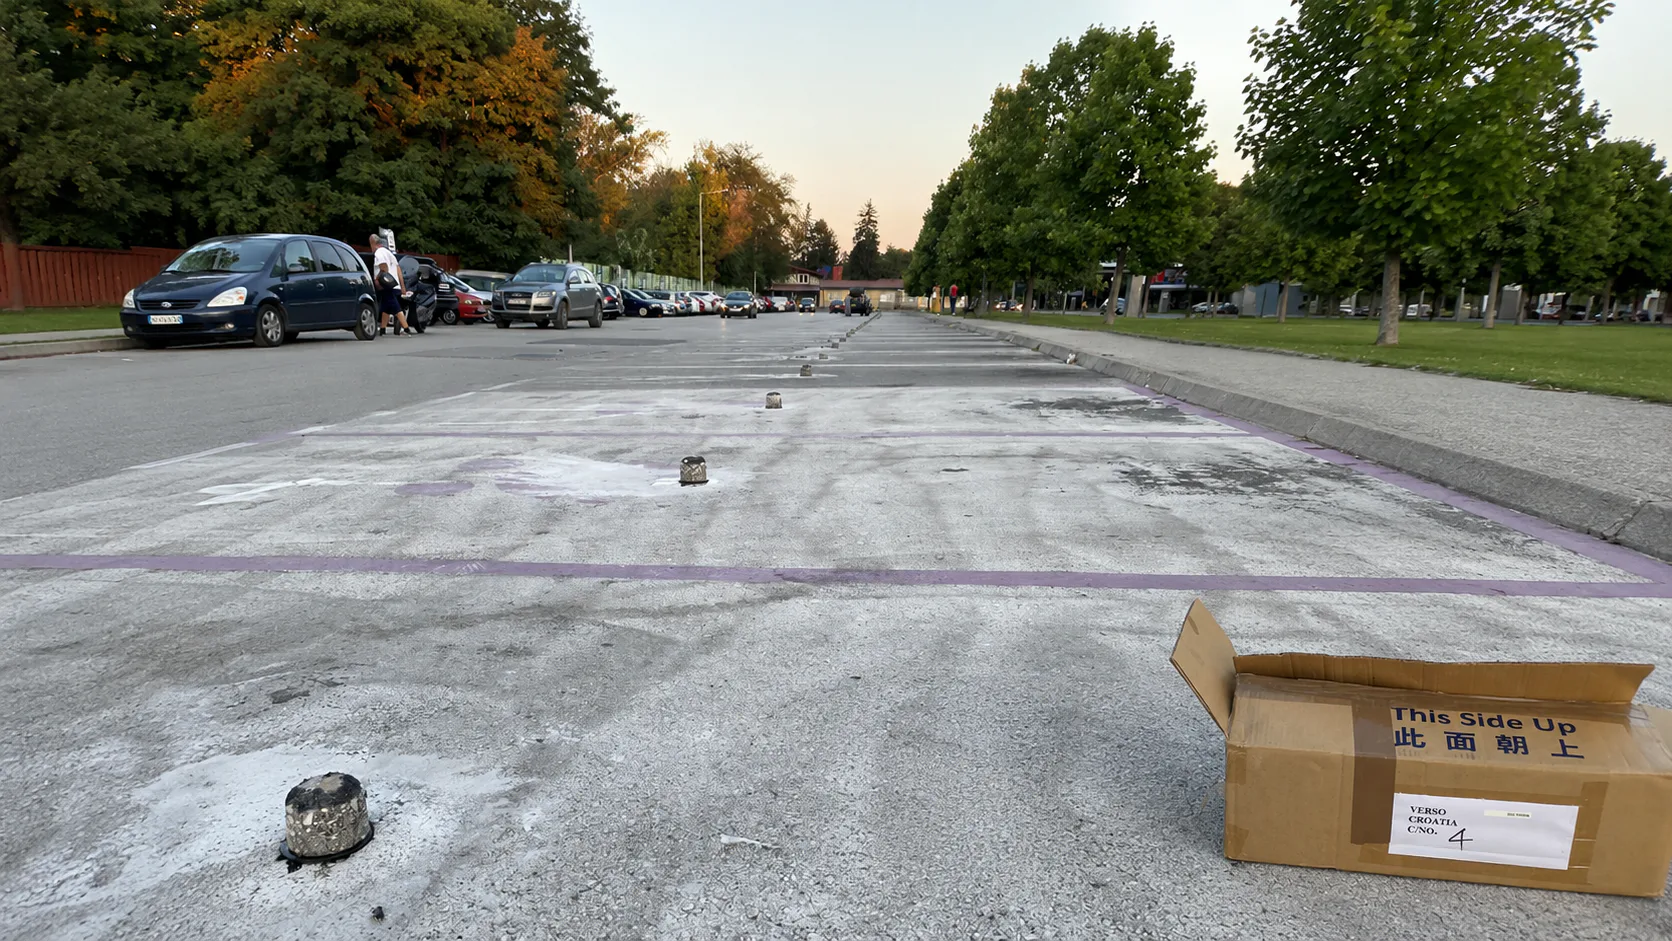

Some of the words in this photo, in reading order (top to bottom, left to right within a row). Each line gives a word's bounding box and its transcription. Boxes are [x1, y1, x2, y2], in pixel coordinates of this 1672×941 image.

[1391, 706, 1451, 725] This
[1460, 712, 1523, 731] Side
[1532, 718, 1576, 736] Up
[1394, 727, 1585, 759] 此面朝上
[1408, 815, 1458, 827] CROATIA
[1410, 805, 1447, 816] VERSO
[1407, 825, 1438, 835] C/NO.
[1448, 828, 1473, 851] 4
